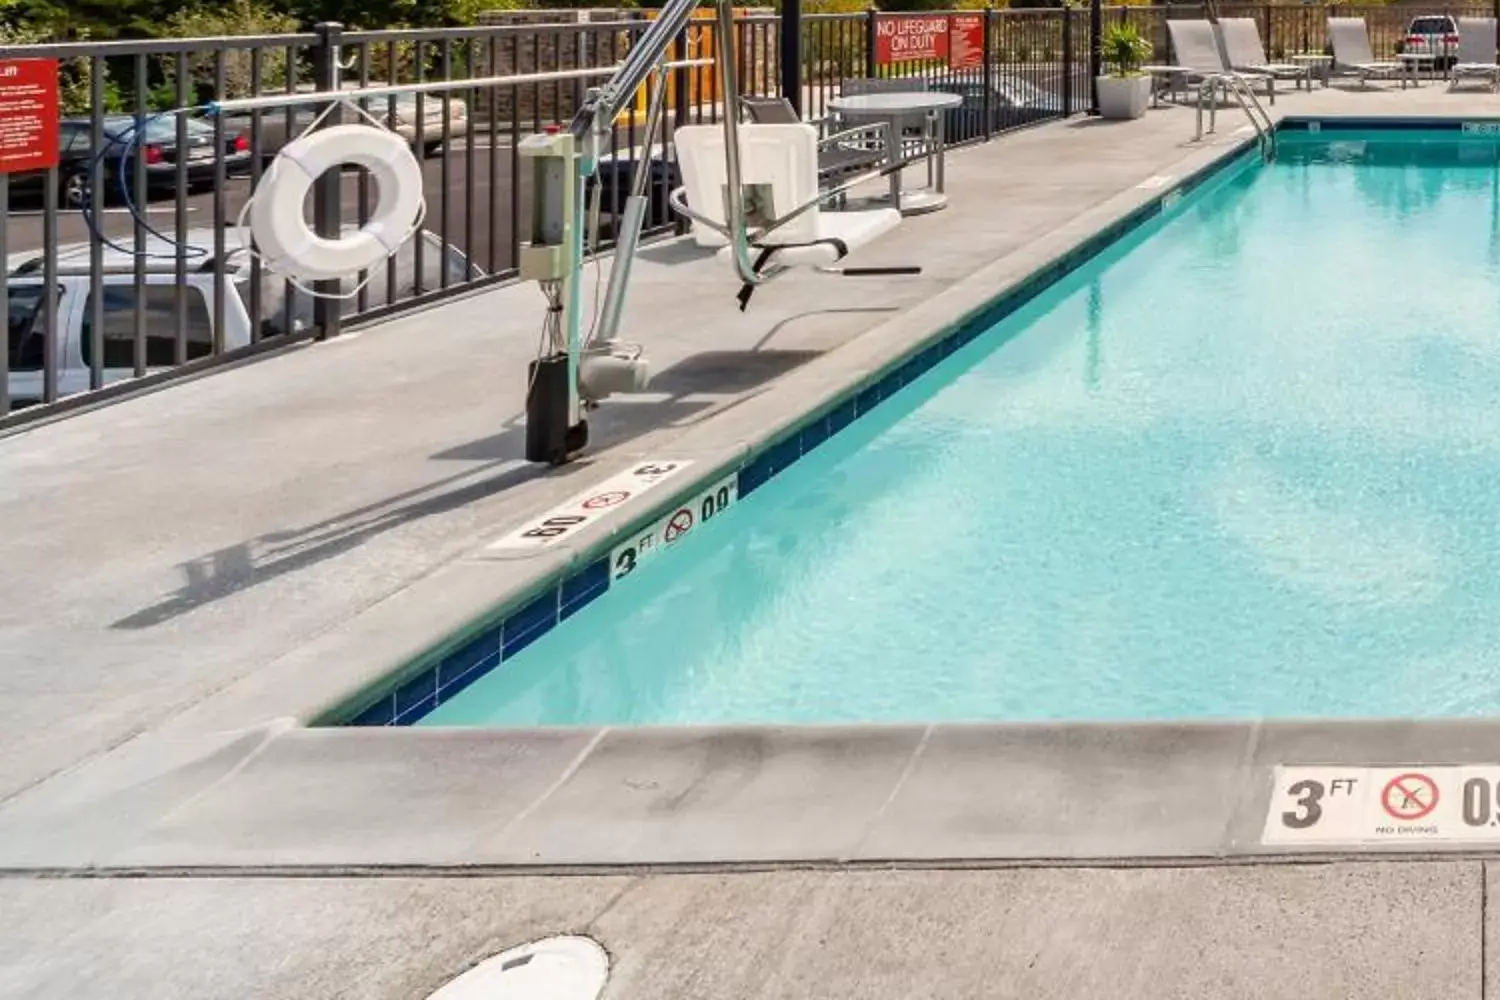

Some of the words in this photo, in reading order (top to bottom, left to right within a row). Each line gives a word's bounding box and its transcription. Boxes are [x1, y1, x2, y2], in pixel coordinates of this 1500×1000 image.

[877, 20, 896, 36] NO
[897, 19, 948, 34] LIFEGUARD
[891, 35, 908, 51] ON
[910, 33, 936, 49] DUTY
[1282, 779, 1325, 829] 3
[1329, 779, 1358, 797] FT
[1375, 826, 1395, 834] NO
[1398, 826, 1438, 834] DIVING
